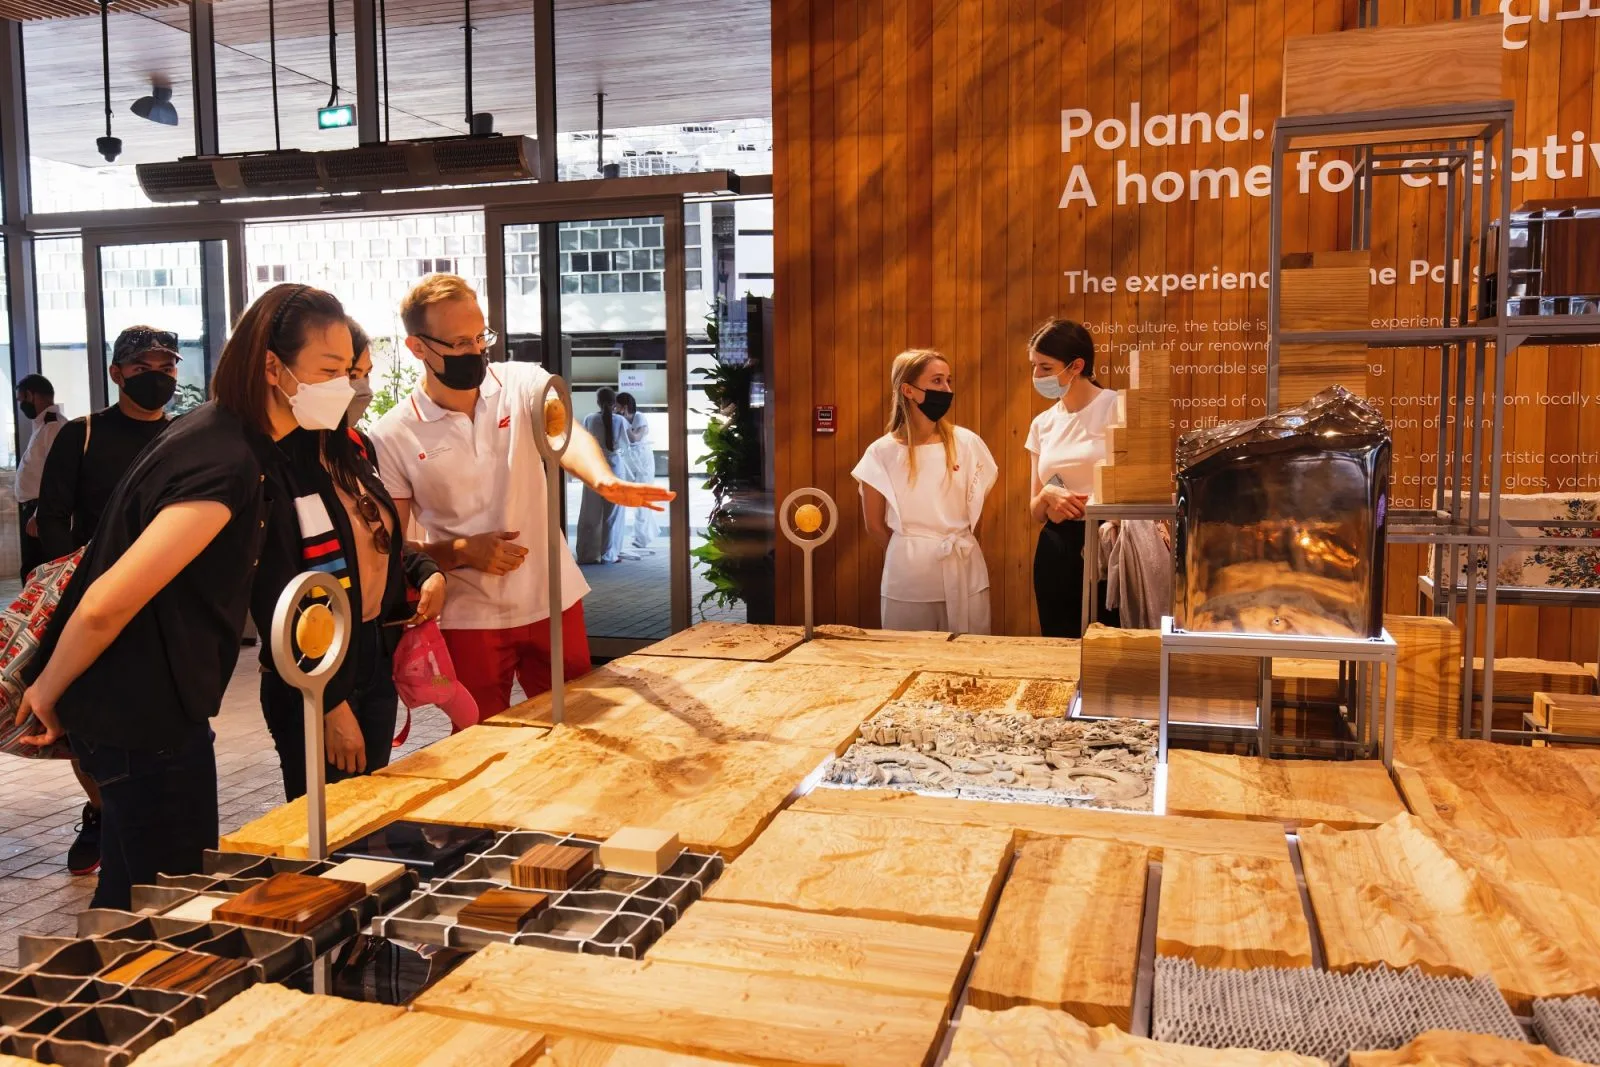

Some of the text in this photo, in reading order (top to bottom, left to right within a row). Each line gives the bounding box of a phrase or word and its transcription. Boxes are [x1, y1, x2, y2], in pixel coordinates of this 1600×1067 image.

[1060, 94, 1265, 153] Poland.
[1058, 164, 1097, 208] A
[1116, 160, 1272, 205] home
[1064, 270, 1117, 294] The
[1125, 266, 1270, 297] experienc
[1083, 321, 1123, 334] Polish
[1128, 320, 1179, 334] culture,
[1184, 320, 1208, 333] the
[1213, 318, 1251, 332] table
[1256, 318, 1267, 331] is
[1160, 339, 1175, 352] of
[1179, 342, 1204, 352] our
[1100, 364, 1109, 375] a
[1231, 394, 1247, 407] of
[1536, 391, 1590, 408] locally
[1179, 421, 1189, 429] a
[1423, 415, 1440, 428] of
[1505, 473, 1550, 490] glass,
[1420, 494, 1432, 508] is
